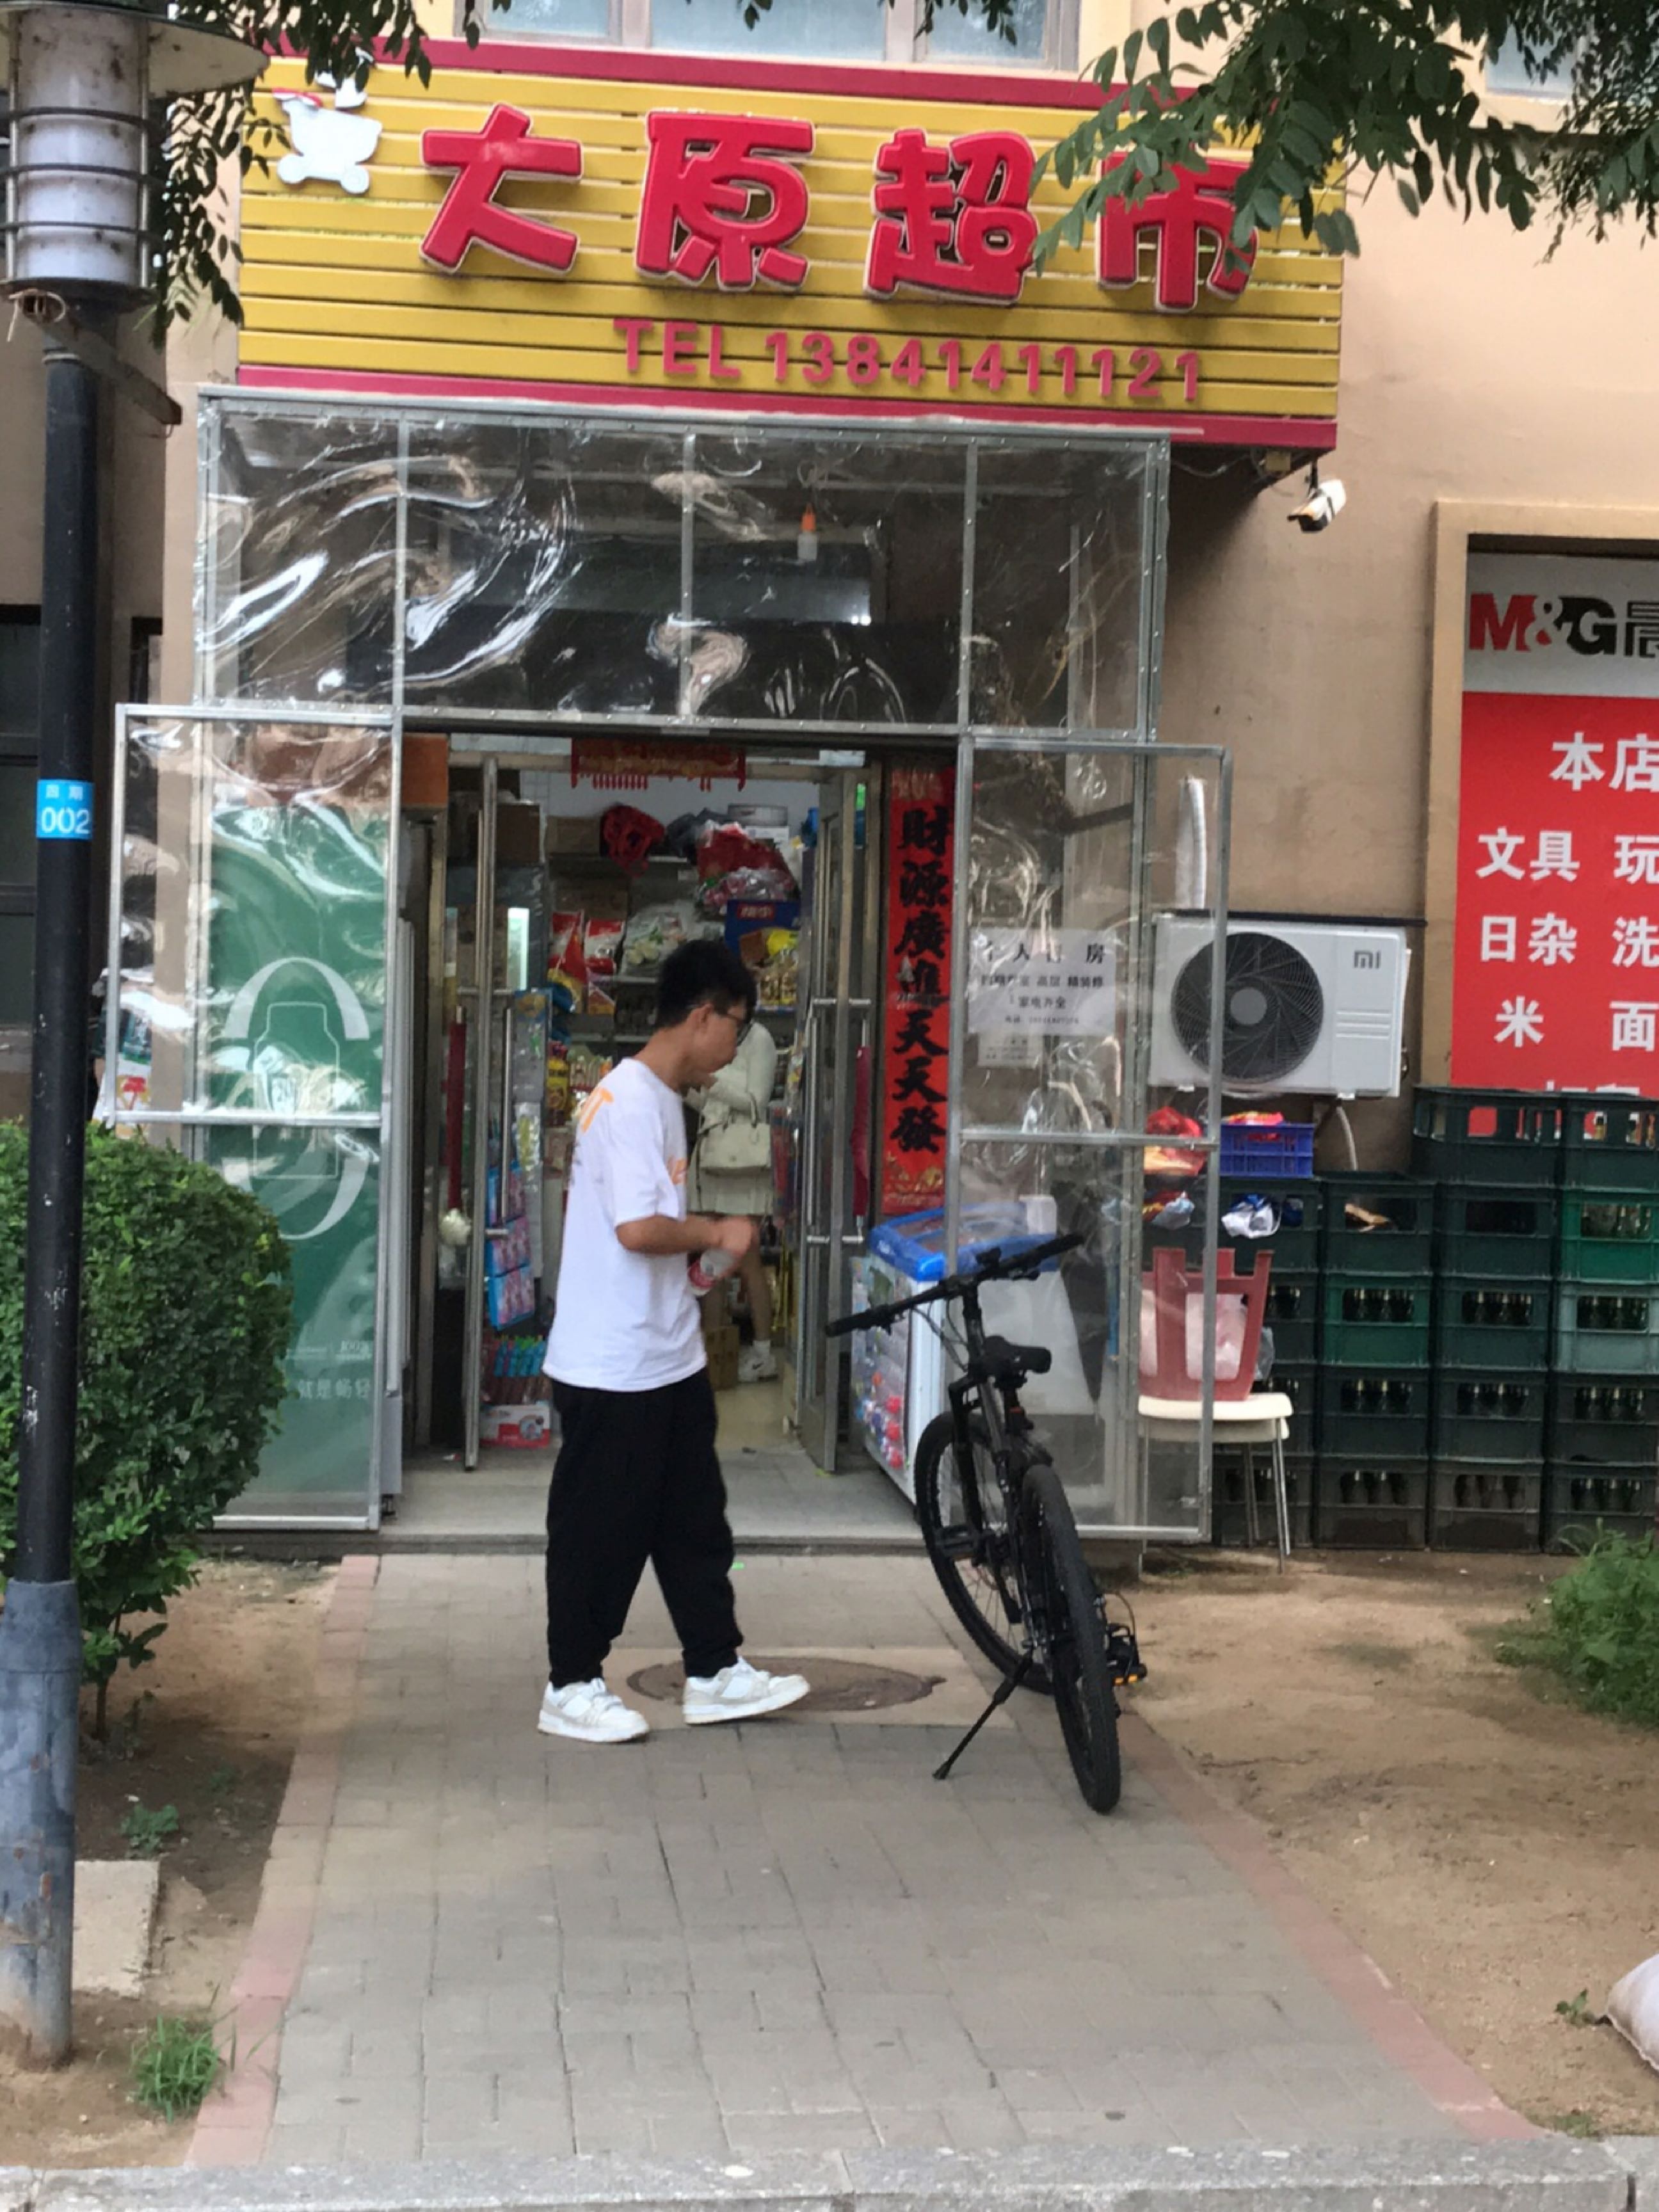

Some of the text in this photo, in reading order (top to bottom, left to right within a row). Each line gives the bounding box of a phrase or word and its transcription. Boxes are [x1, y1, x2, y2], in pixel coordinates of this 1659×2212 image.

[420, 103, 1258, 313] 大原超市
[613, 318, 1199, 401] TEL 13841411121
[1549, 731, 1659, 792] 本店
[41, 806, 91, 835] 002
[1476, 826, 1659, 884] 文具 玩
[1480, 912, 1659, 967] 日杂 洗
[1494, 996, 1659, 1051] 米 面
